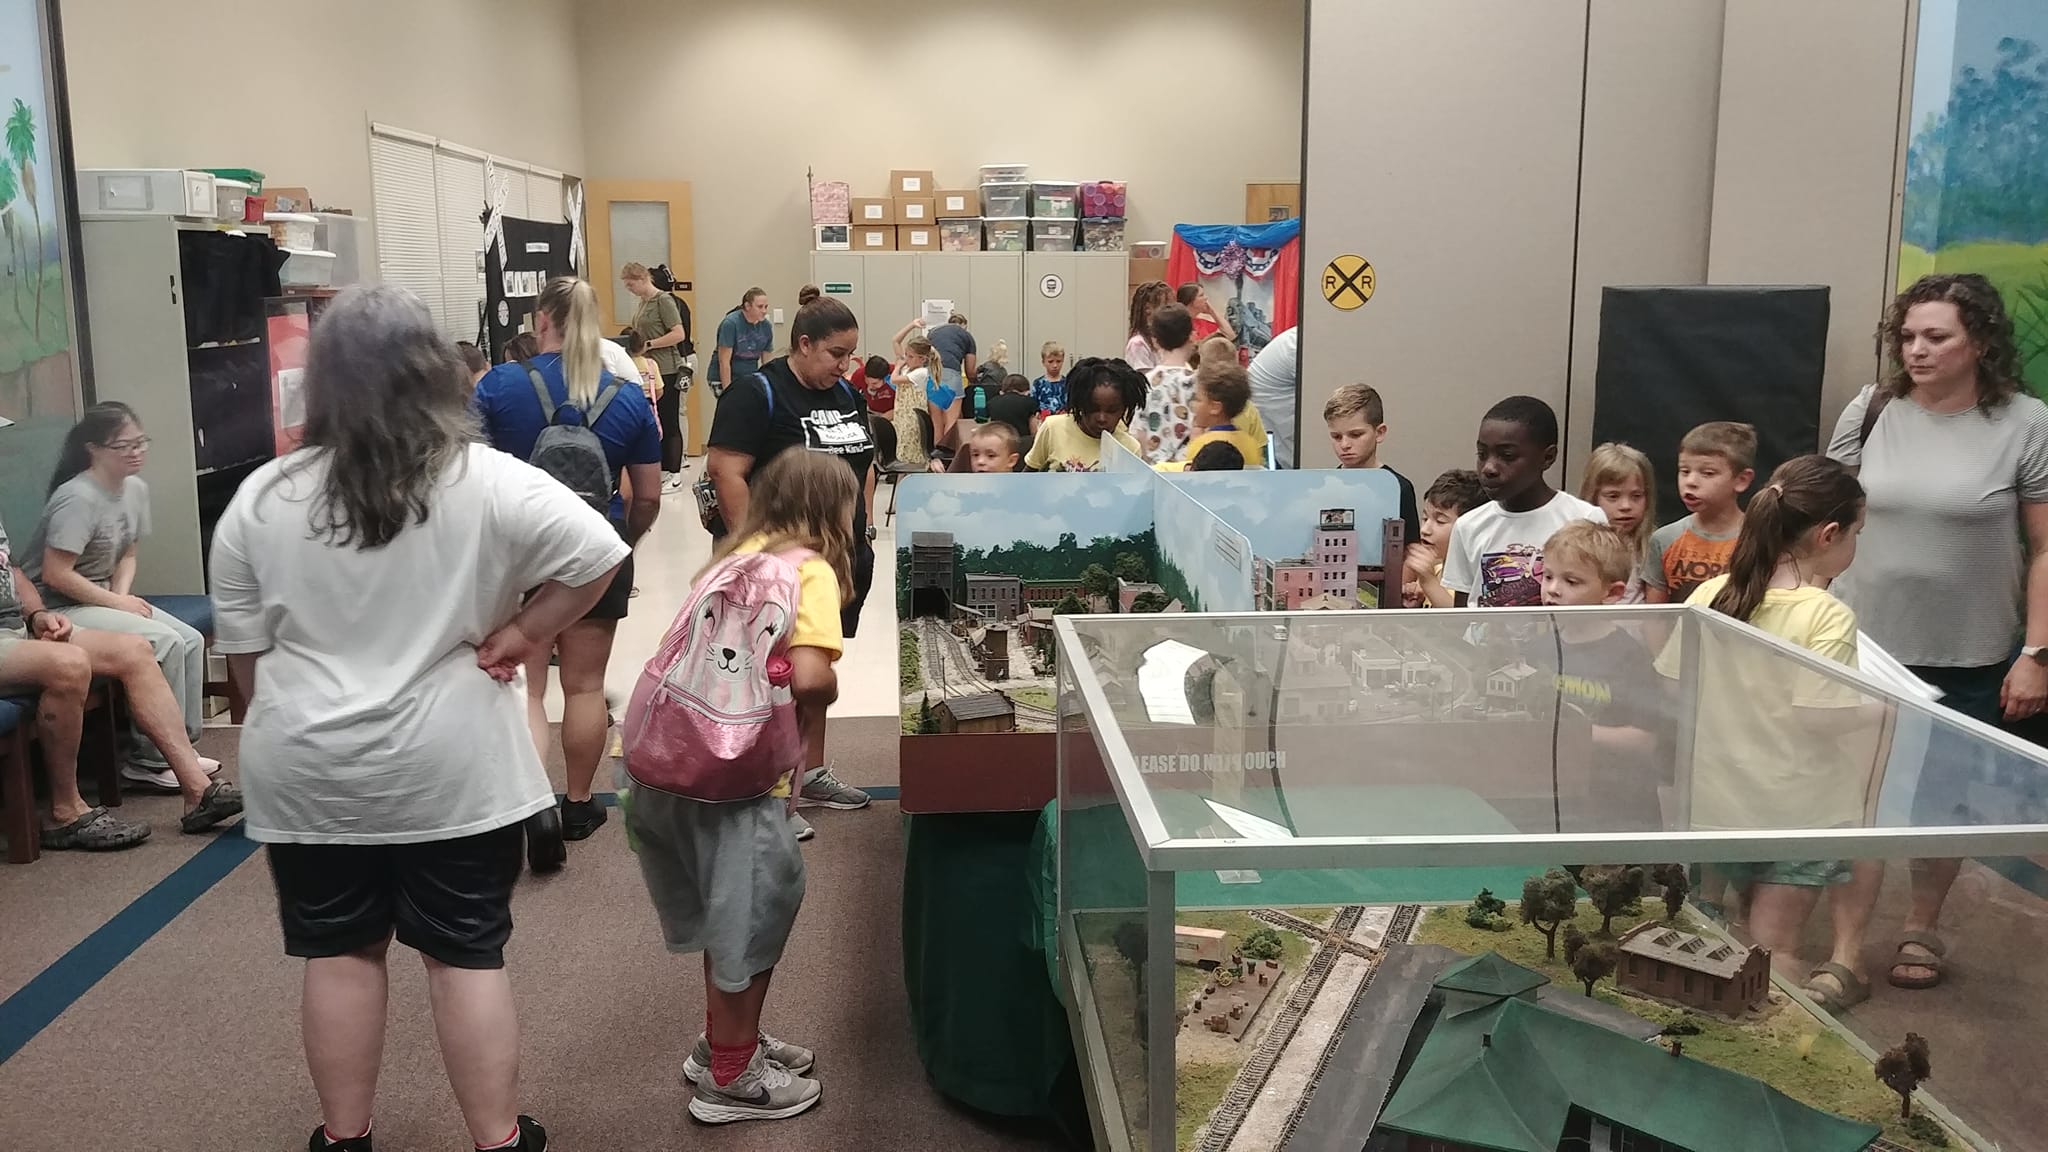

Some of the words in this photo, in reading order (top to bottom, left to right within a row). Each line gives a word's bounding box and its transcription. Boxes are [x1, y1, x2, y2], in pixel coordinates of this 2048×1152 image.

[1325, 275, 1336, 289] R
[1361, 275, 1372, 289] R
[1179, 753, 1200, 772] DO
